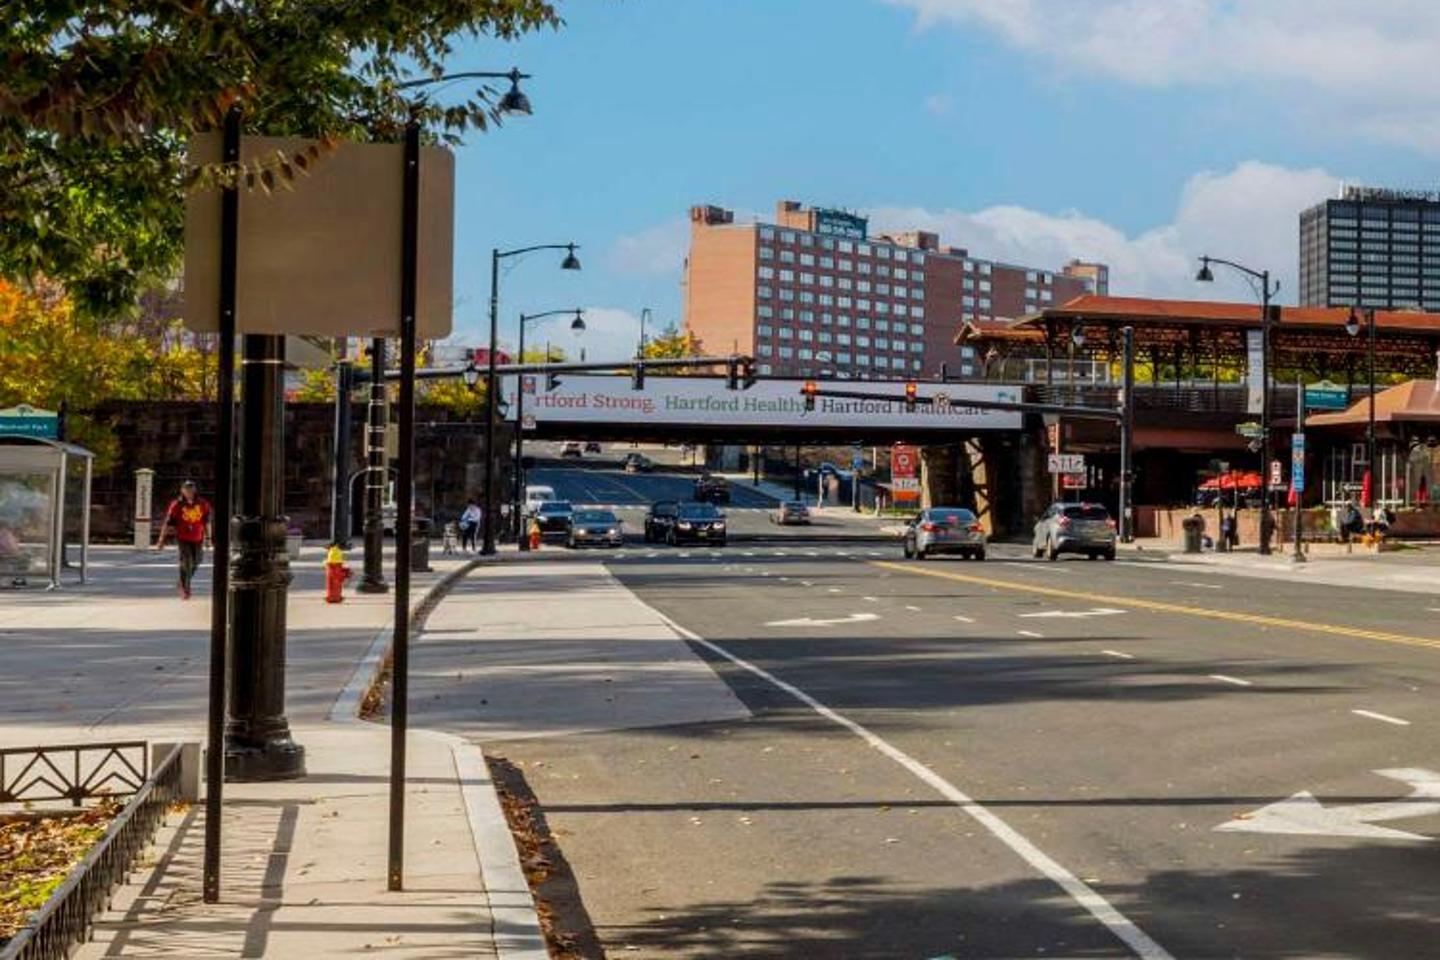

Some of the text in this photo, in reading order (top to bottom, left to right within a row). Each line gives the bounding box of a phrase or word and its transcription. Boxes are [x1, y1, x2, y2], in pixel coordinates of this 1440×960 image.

[509, 392, 587, 408] Hrtford
[665, 395, 739, 411] Hartford
[822, 397, 892, 414] Hartford
[898, 399, 990, 416] althCare
